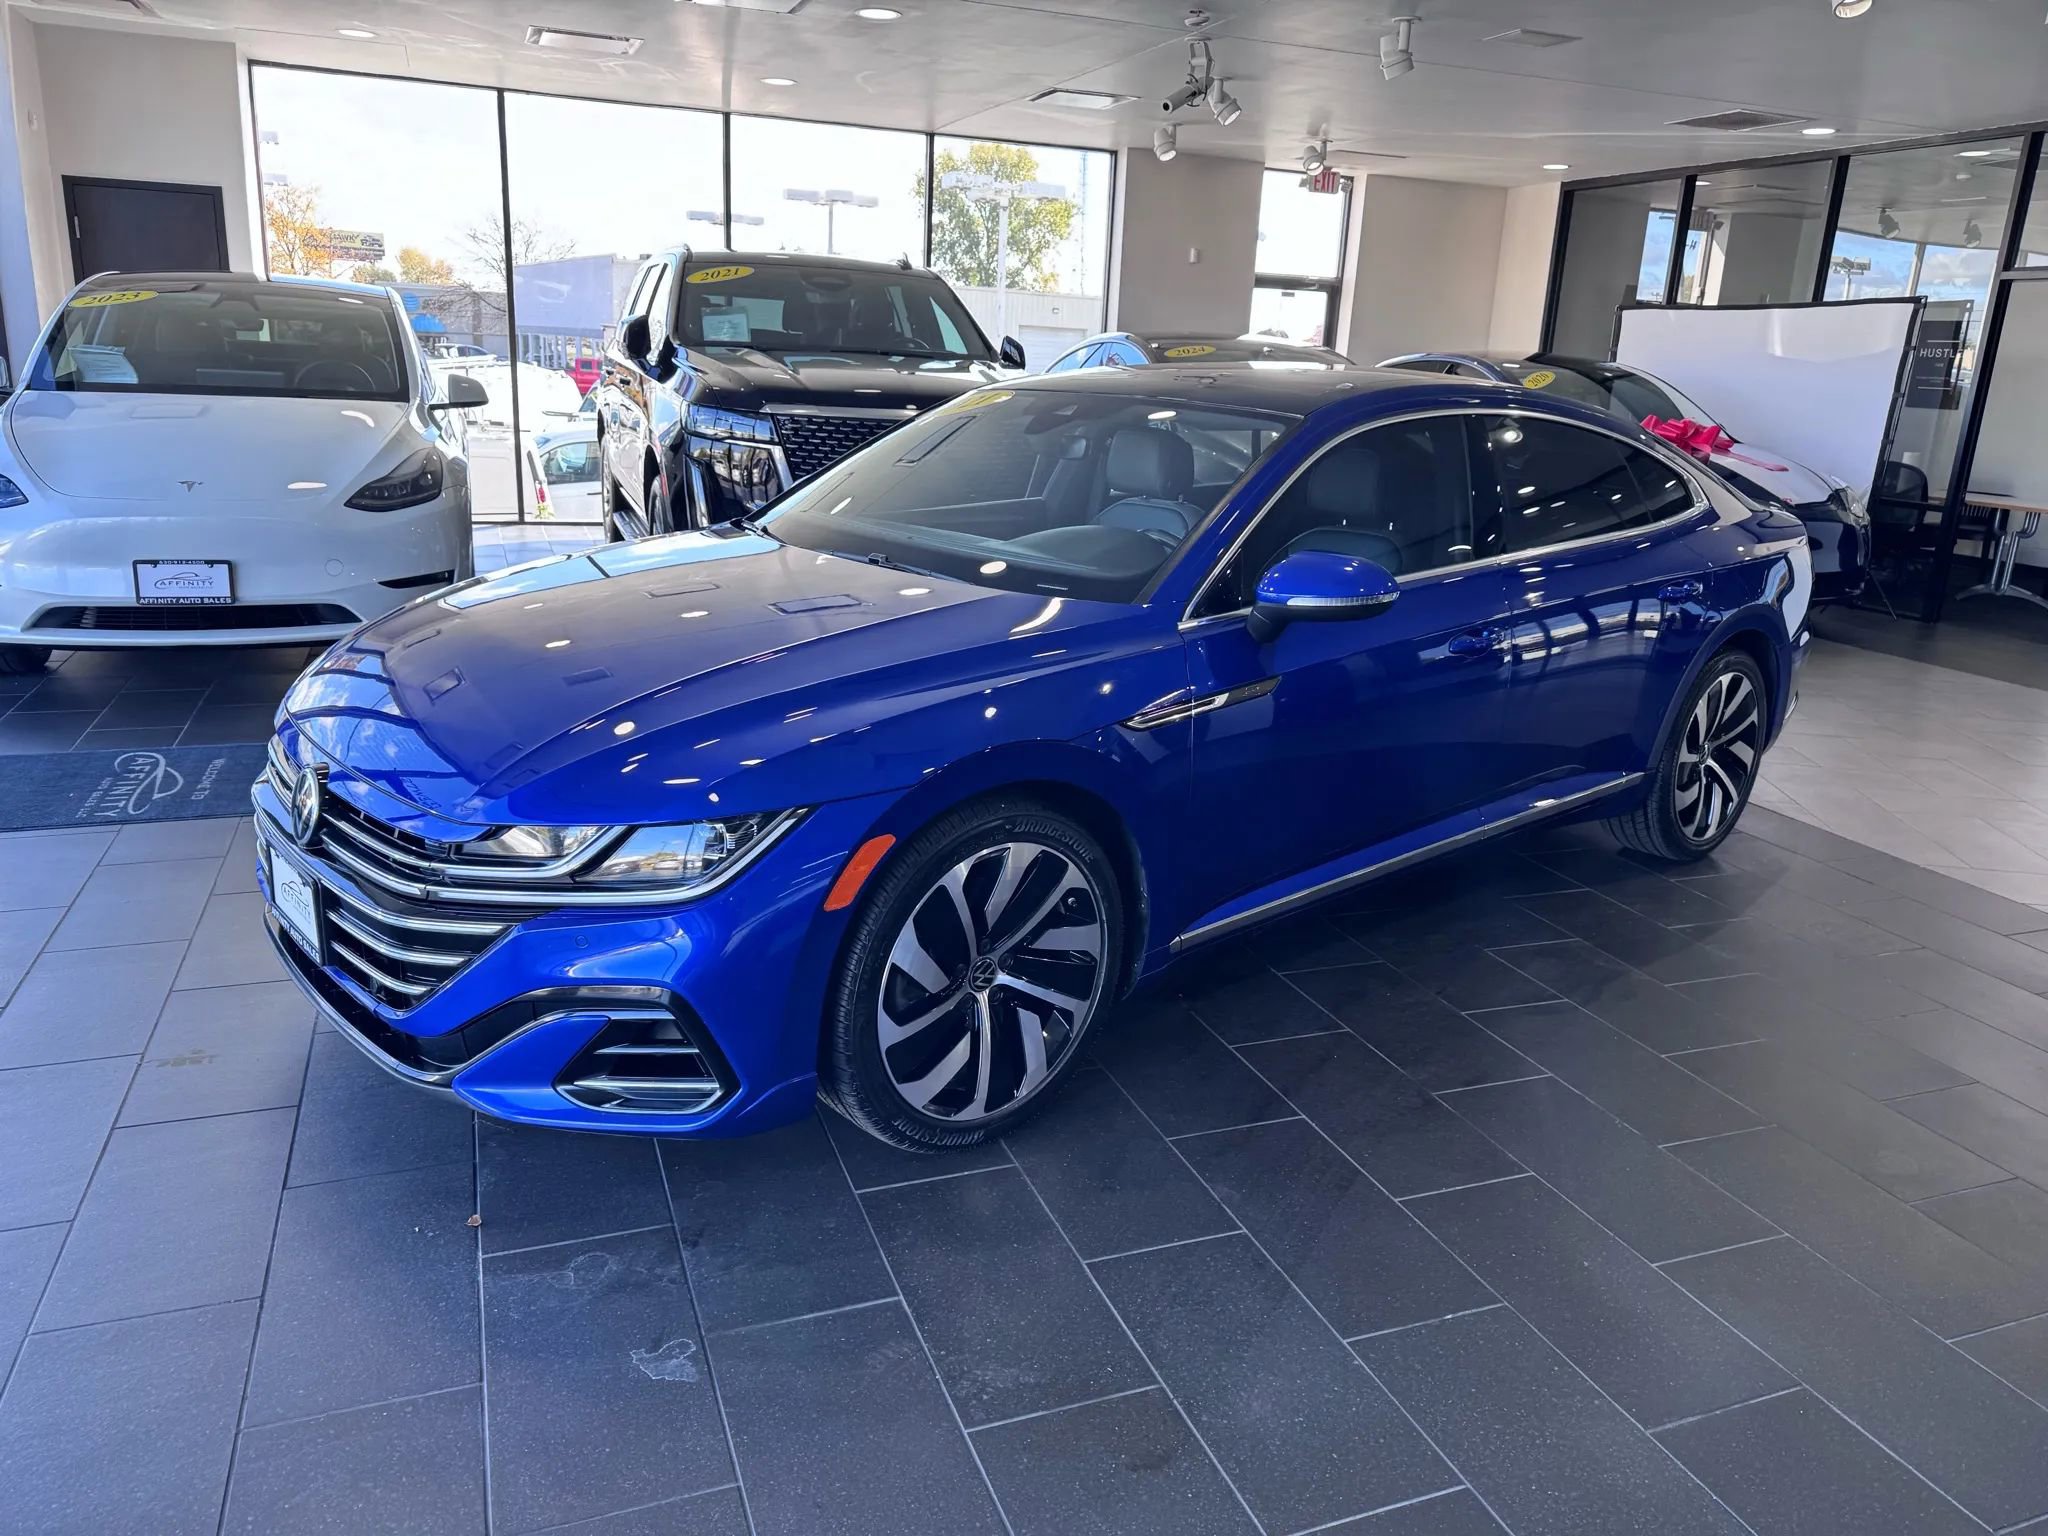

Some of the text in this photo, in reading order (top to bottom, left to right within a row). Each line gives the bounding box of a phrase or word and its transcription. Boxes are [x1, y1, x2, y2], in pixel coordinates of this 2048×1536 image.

[1313, 171, 1337, 192] EXIT
[700, 267, 740, 281] 2021
[82, 291, 141, 305] 2023
[1175, 346, 1205, 356] 2024
[1527, 372, 1550, 387] 2020
[94, 757, 156, 817] AFFINITY
